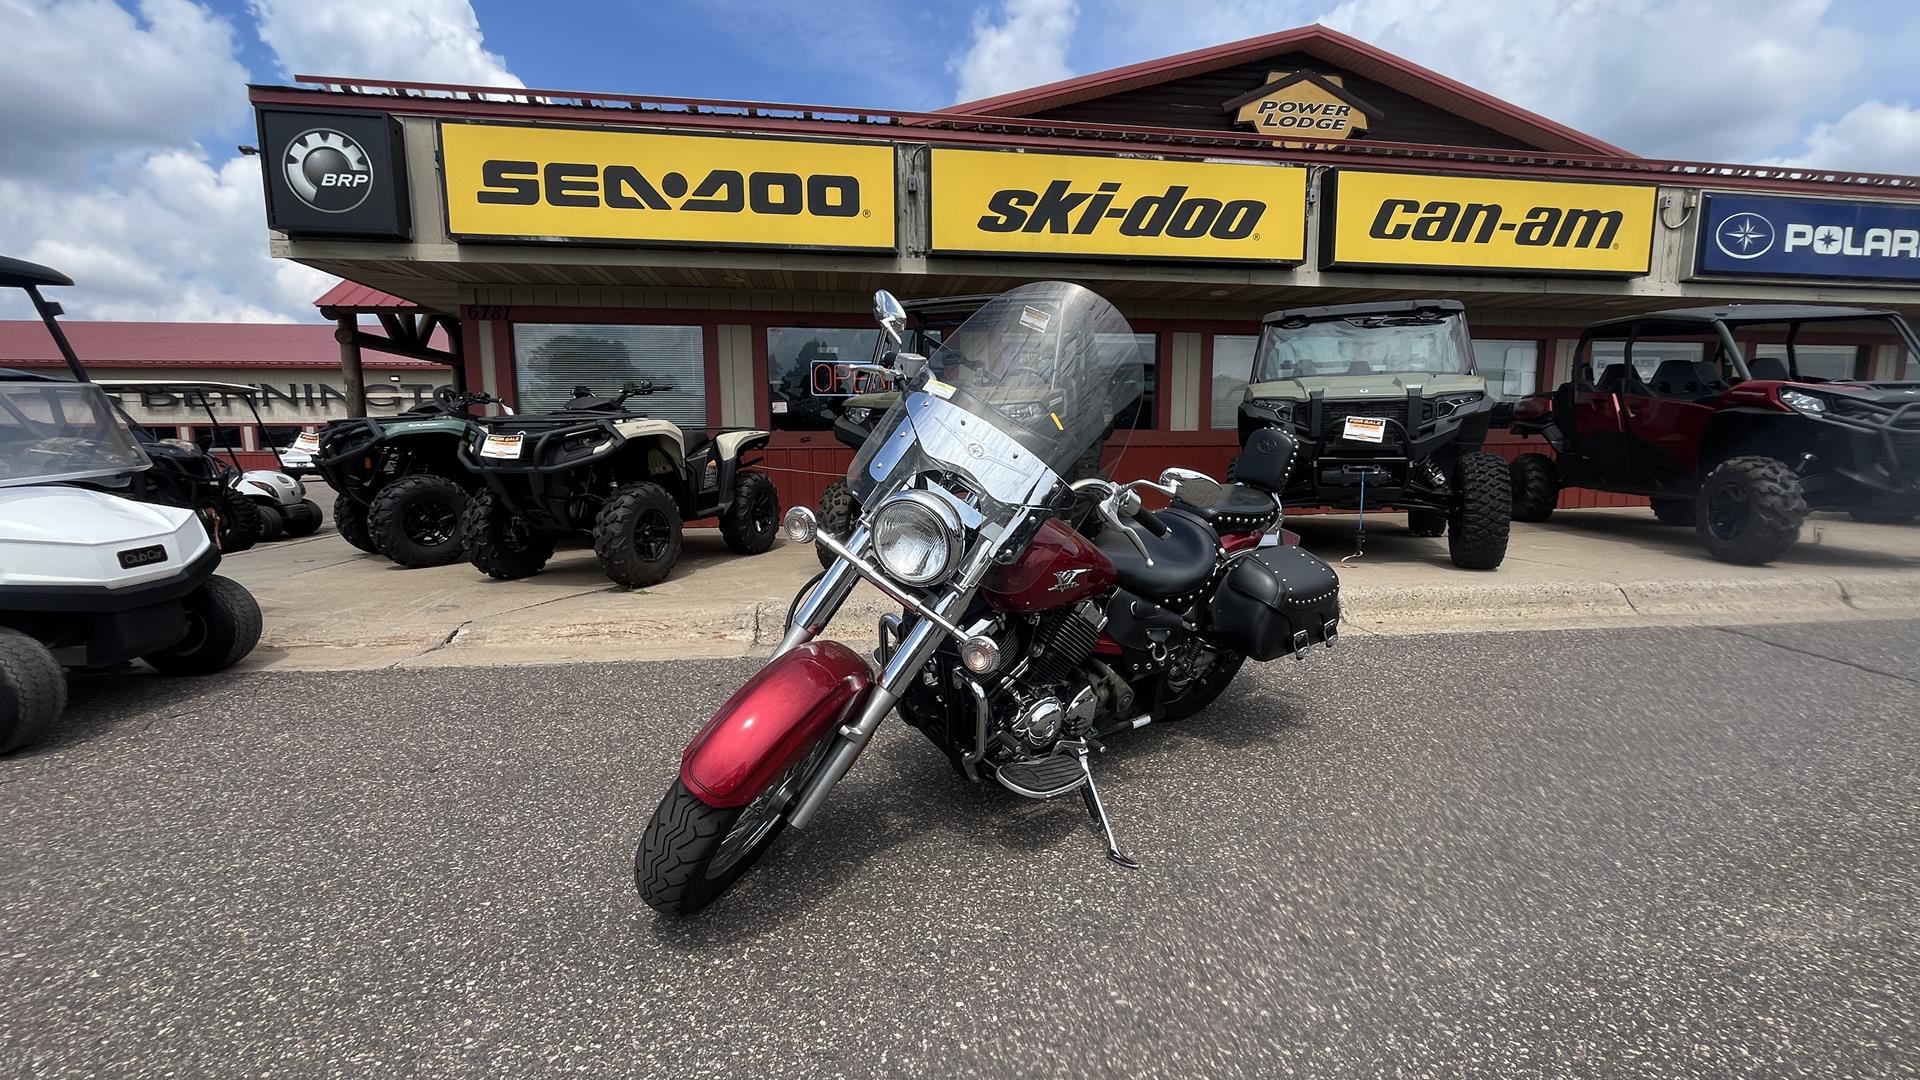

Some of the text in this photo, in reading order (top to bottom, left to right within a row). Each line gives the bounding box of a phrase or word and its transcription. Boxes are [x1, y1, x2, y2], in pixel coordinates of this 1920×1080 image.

[1257, 100, 1351, 117] POWER
[1262, 112, 1347, 131] LODGE
[321, 173, 368, 187] BRP
[977, 180, 1266, 240] ski-doo
[1369, 199, 1623, 249] can-am
[1784, 223, 1920, 258] POLAR
[467, 304, 511, 320] 6781
